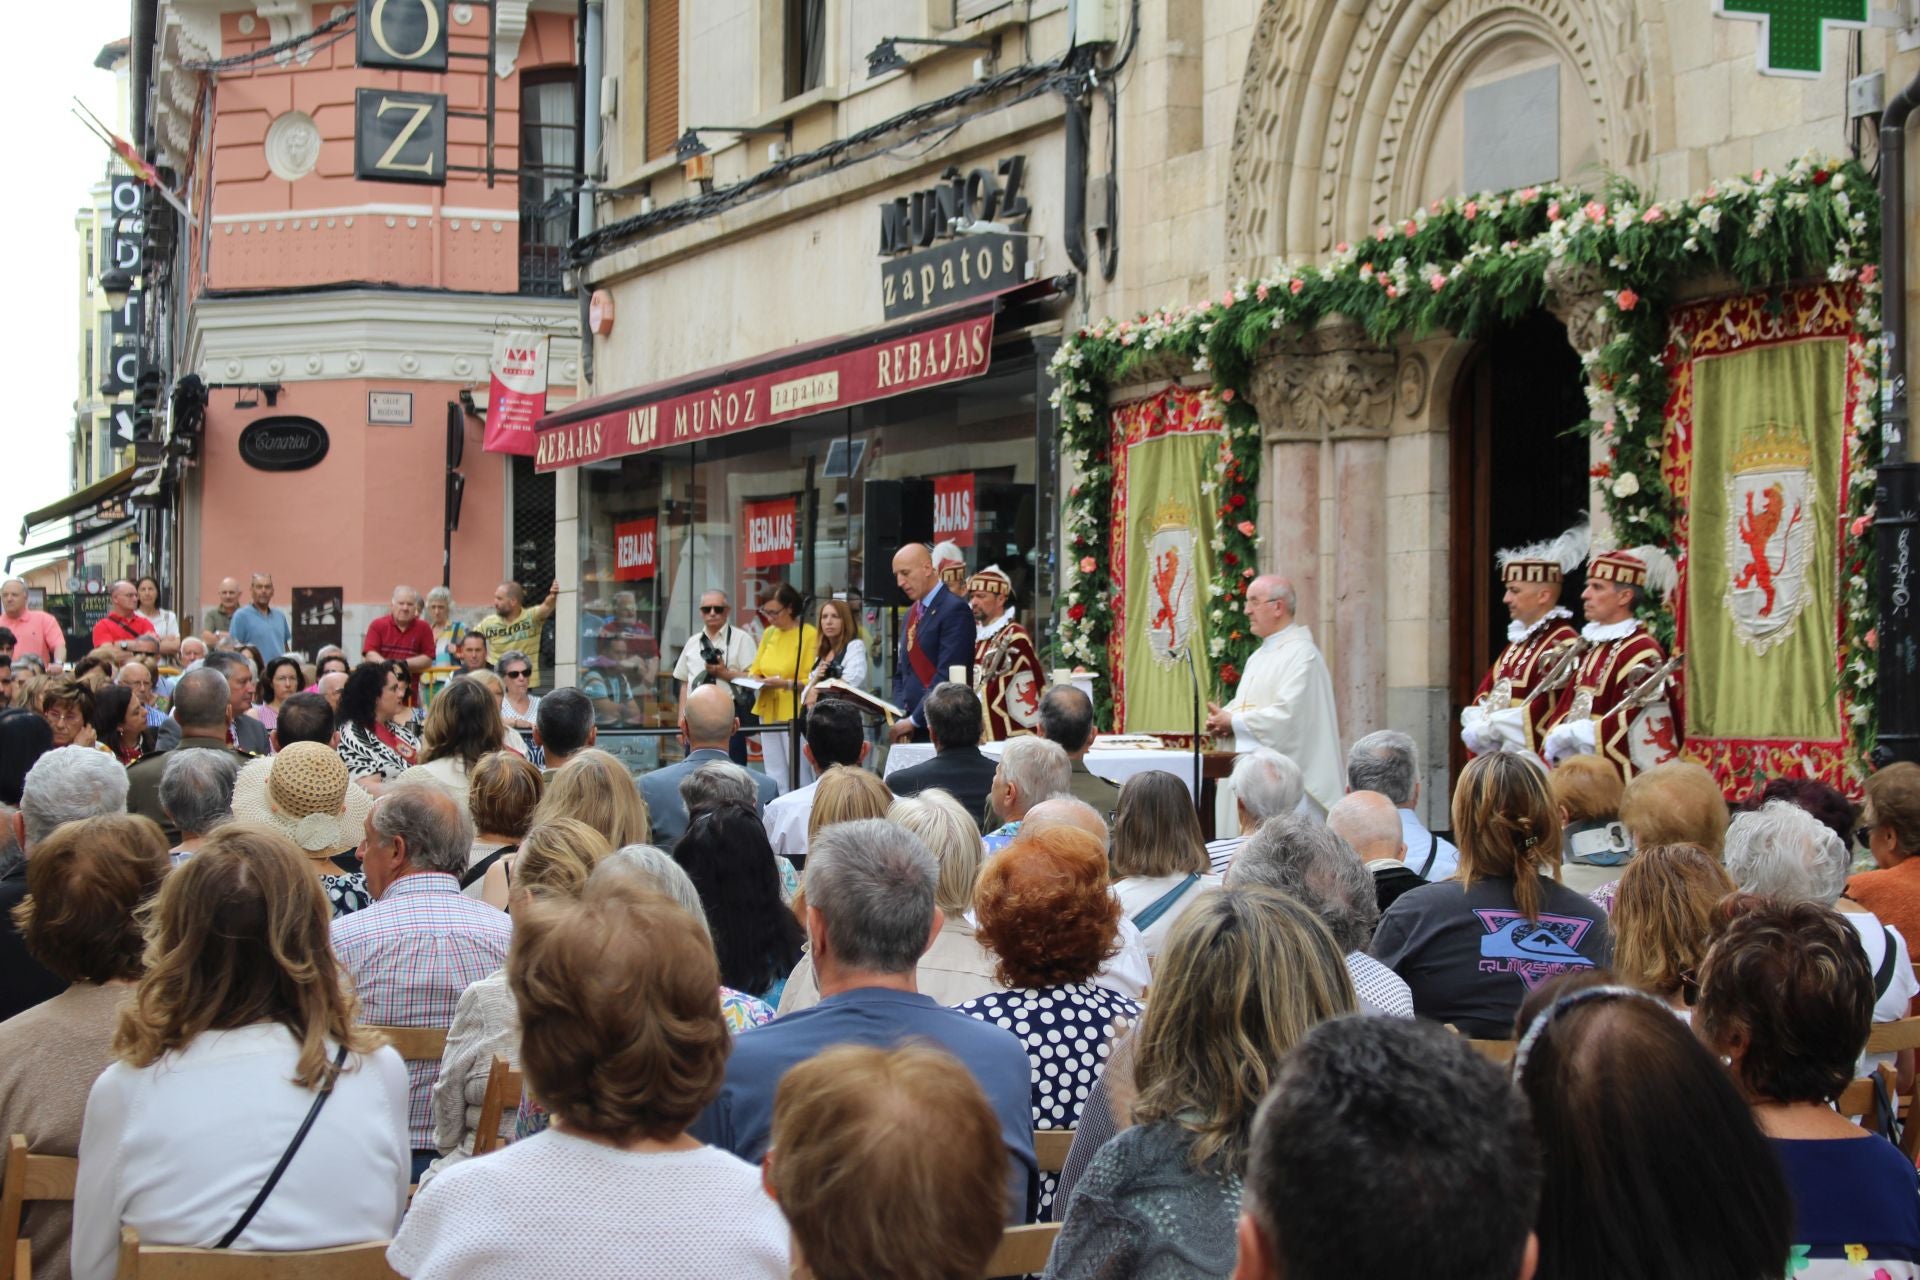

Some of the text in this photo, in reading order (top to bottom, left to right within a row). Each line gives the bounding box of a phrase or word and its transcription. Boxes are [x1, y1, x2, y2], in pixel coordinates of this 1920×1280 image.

[877, 155, 1031, 257] MUÑOZ
[883, 240, 1014, 307] zapatos
[536, 422, 601, 465] REBAJAS
[674, 388, 756, 438] MUÑOZ
[774, 378, 834, 407] zapatos
[876, 324, 985, 389] REBAJAS
[617, 531, 653, 569] REBAJAS
[748, 513, 793, 554] REBAJAS
